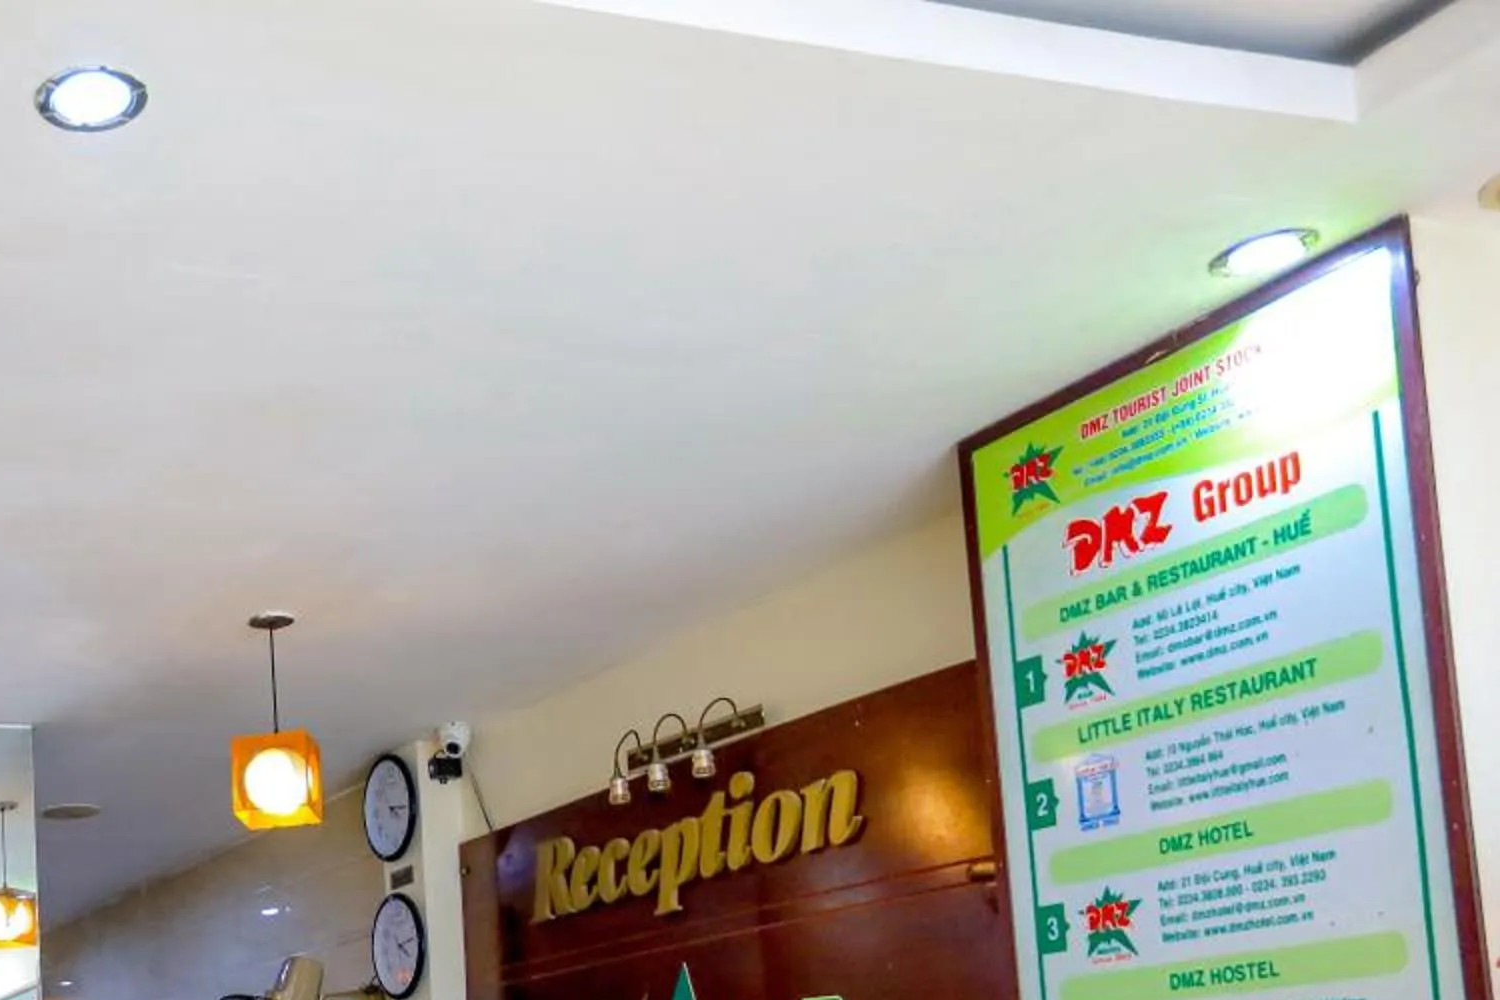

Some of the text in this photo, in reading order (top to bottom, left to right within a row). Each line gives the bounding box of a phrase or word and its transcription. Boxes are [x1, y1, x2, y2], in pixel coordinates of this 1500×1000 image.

[1080, 412, 1109, 440] DMZ
[1112, 386, 1167, 424] TOURIST
[1171, 365, 1211, 397] JOINT
[1010, 447, 1052, 494] DMZ
[1062, 451, 1302, 577] DMZ Group
[1059, 597, 1090, 624] DMZ
[1095, 584, 1126, 611] BAR
[1130, 578, 1142, 598] &
[1147, 535, 1257, 592] RESTAURANT
[1272, 508, 1312, 547] HUẾ
[1275, 561, 1300, 582] Nam
[1060, 638, 1107, 682] DMZ
[1025, 670, 1035, 694] 1
[1077, 658, 1318, 744] LITTLE ITALY RESTAURANT
[1322, 698, 1345, 714] Nam
[1035, 793, 1048, 817] 2
[530, 769, 863, 925] Reception
[1158, 818, 1253, 855] DMZ HOTEL
[1312, 848, 1336, 863] Nam
[1046, 916, 1059, 941] 3
[1084, 896, 1131, 933] DMZ
[1169, 959, 1279, 990] DMZ HOSTEL
